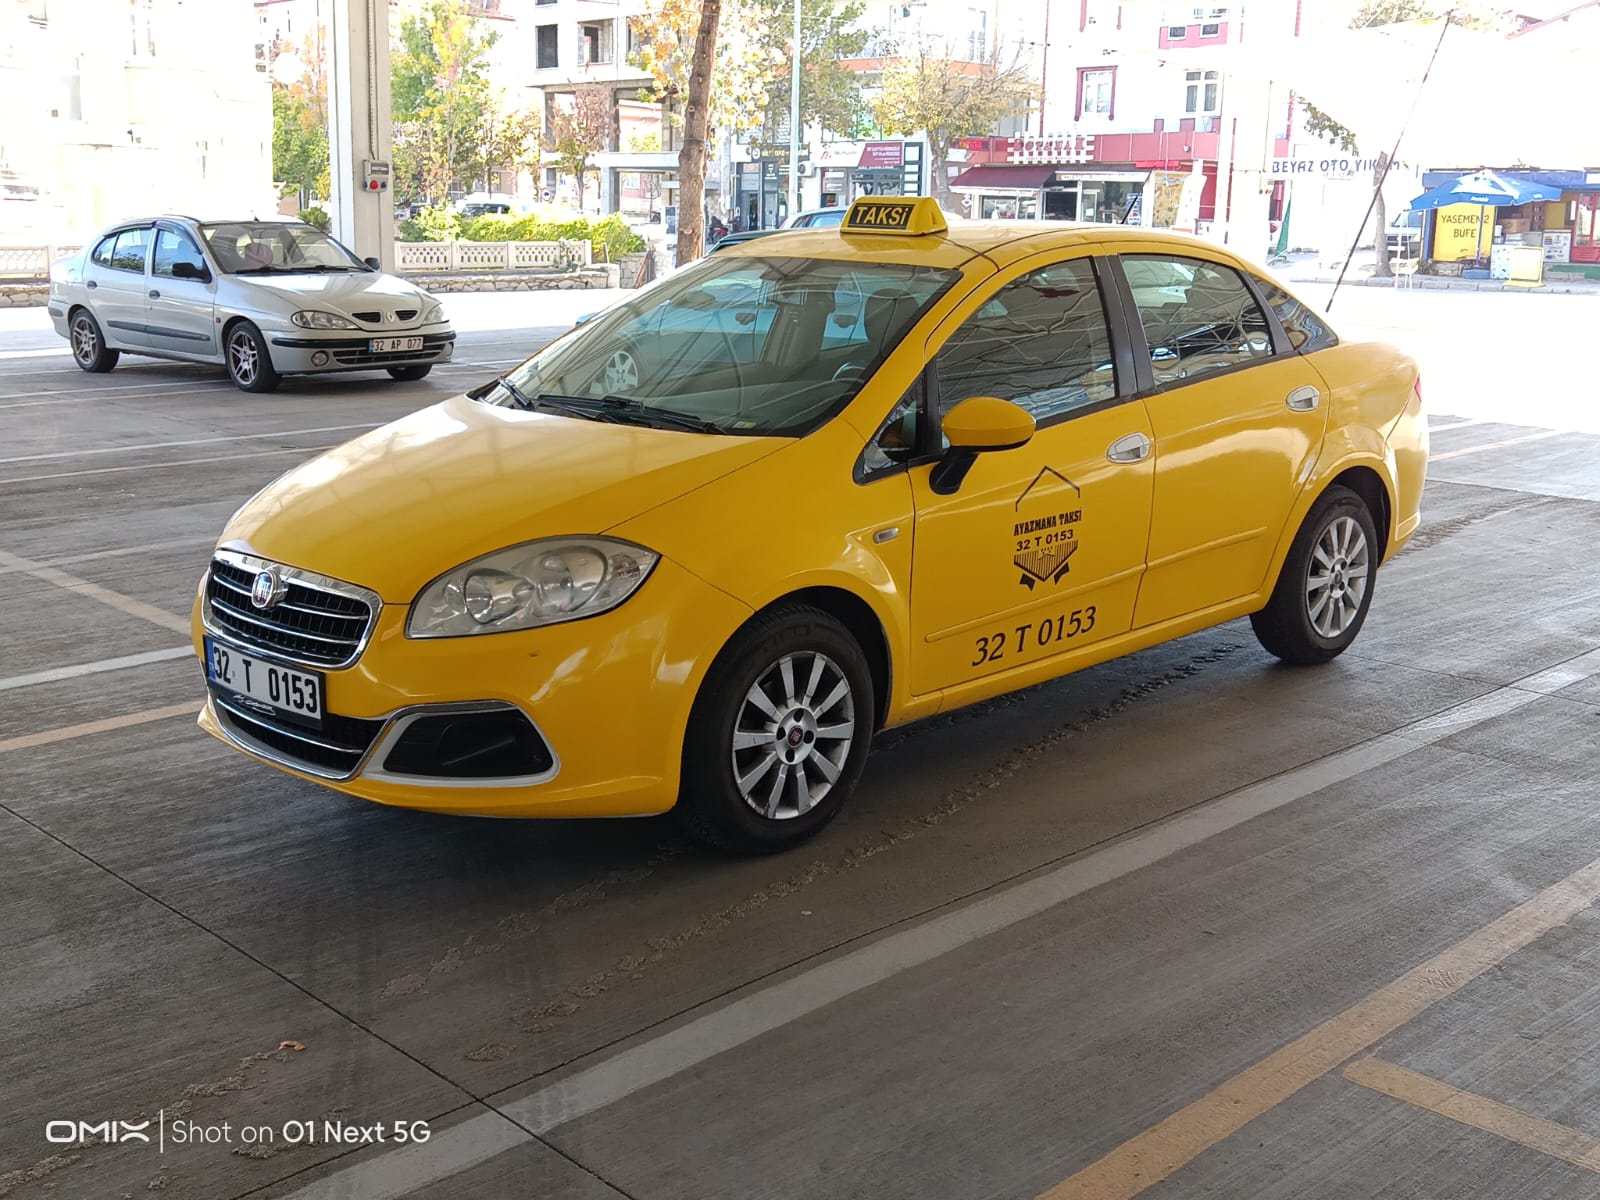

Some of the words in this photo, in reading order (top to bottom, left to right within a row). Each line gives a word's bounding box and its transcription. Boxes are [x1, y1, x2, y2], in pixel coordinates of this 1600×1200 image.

[1272, 160, 1314, 173] BEYAZ
[1320, 159, 1349, 172] OTO
[1484, 214, 1490, 224] 2
[374, 340, 384, 351] 32
[391, 340, 401, 350] AP
[408, 338, 421, 348] 077
[1014, 515, 1057, 536] AYAZMANA
[1016, 539, 1031, 551] 32
[1035, 536, 1043, 546] T
[1045, 529, 1074, 545] 0153
[972, 632, 1006, 667] 32
[1015, 624, 1032, 653] T
[1038, 605, 1096, 646] 0153
[213, 646, 231, 684] 32
[242, 658, 252, 693] T
[268, 667, 318, 713] 0153
